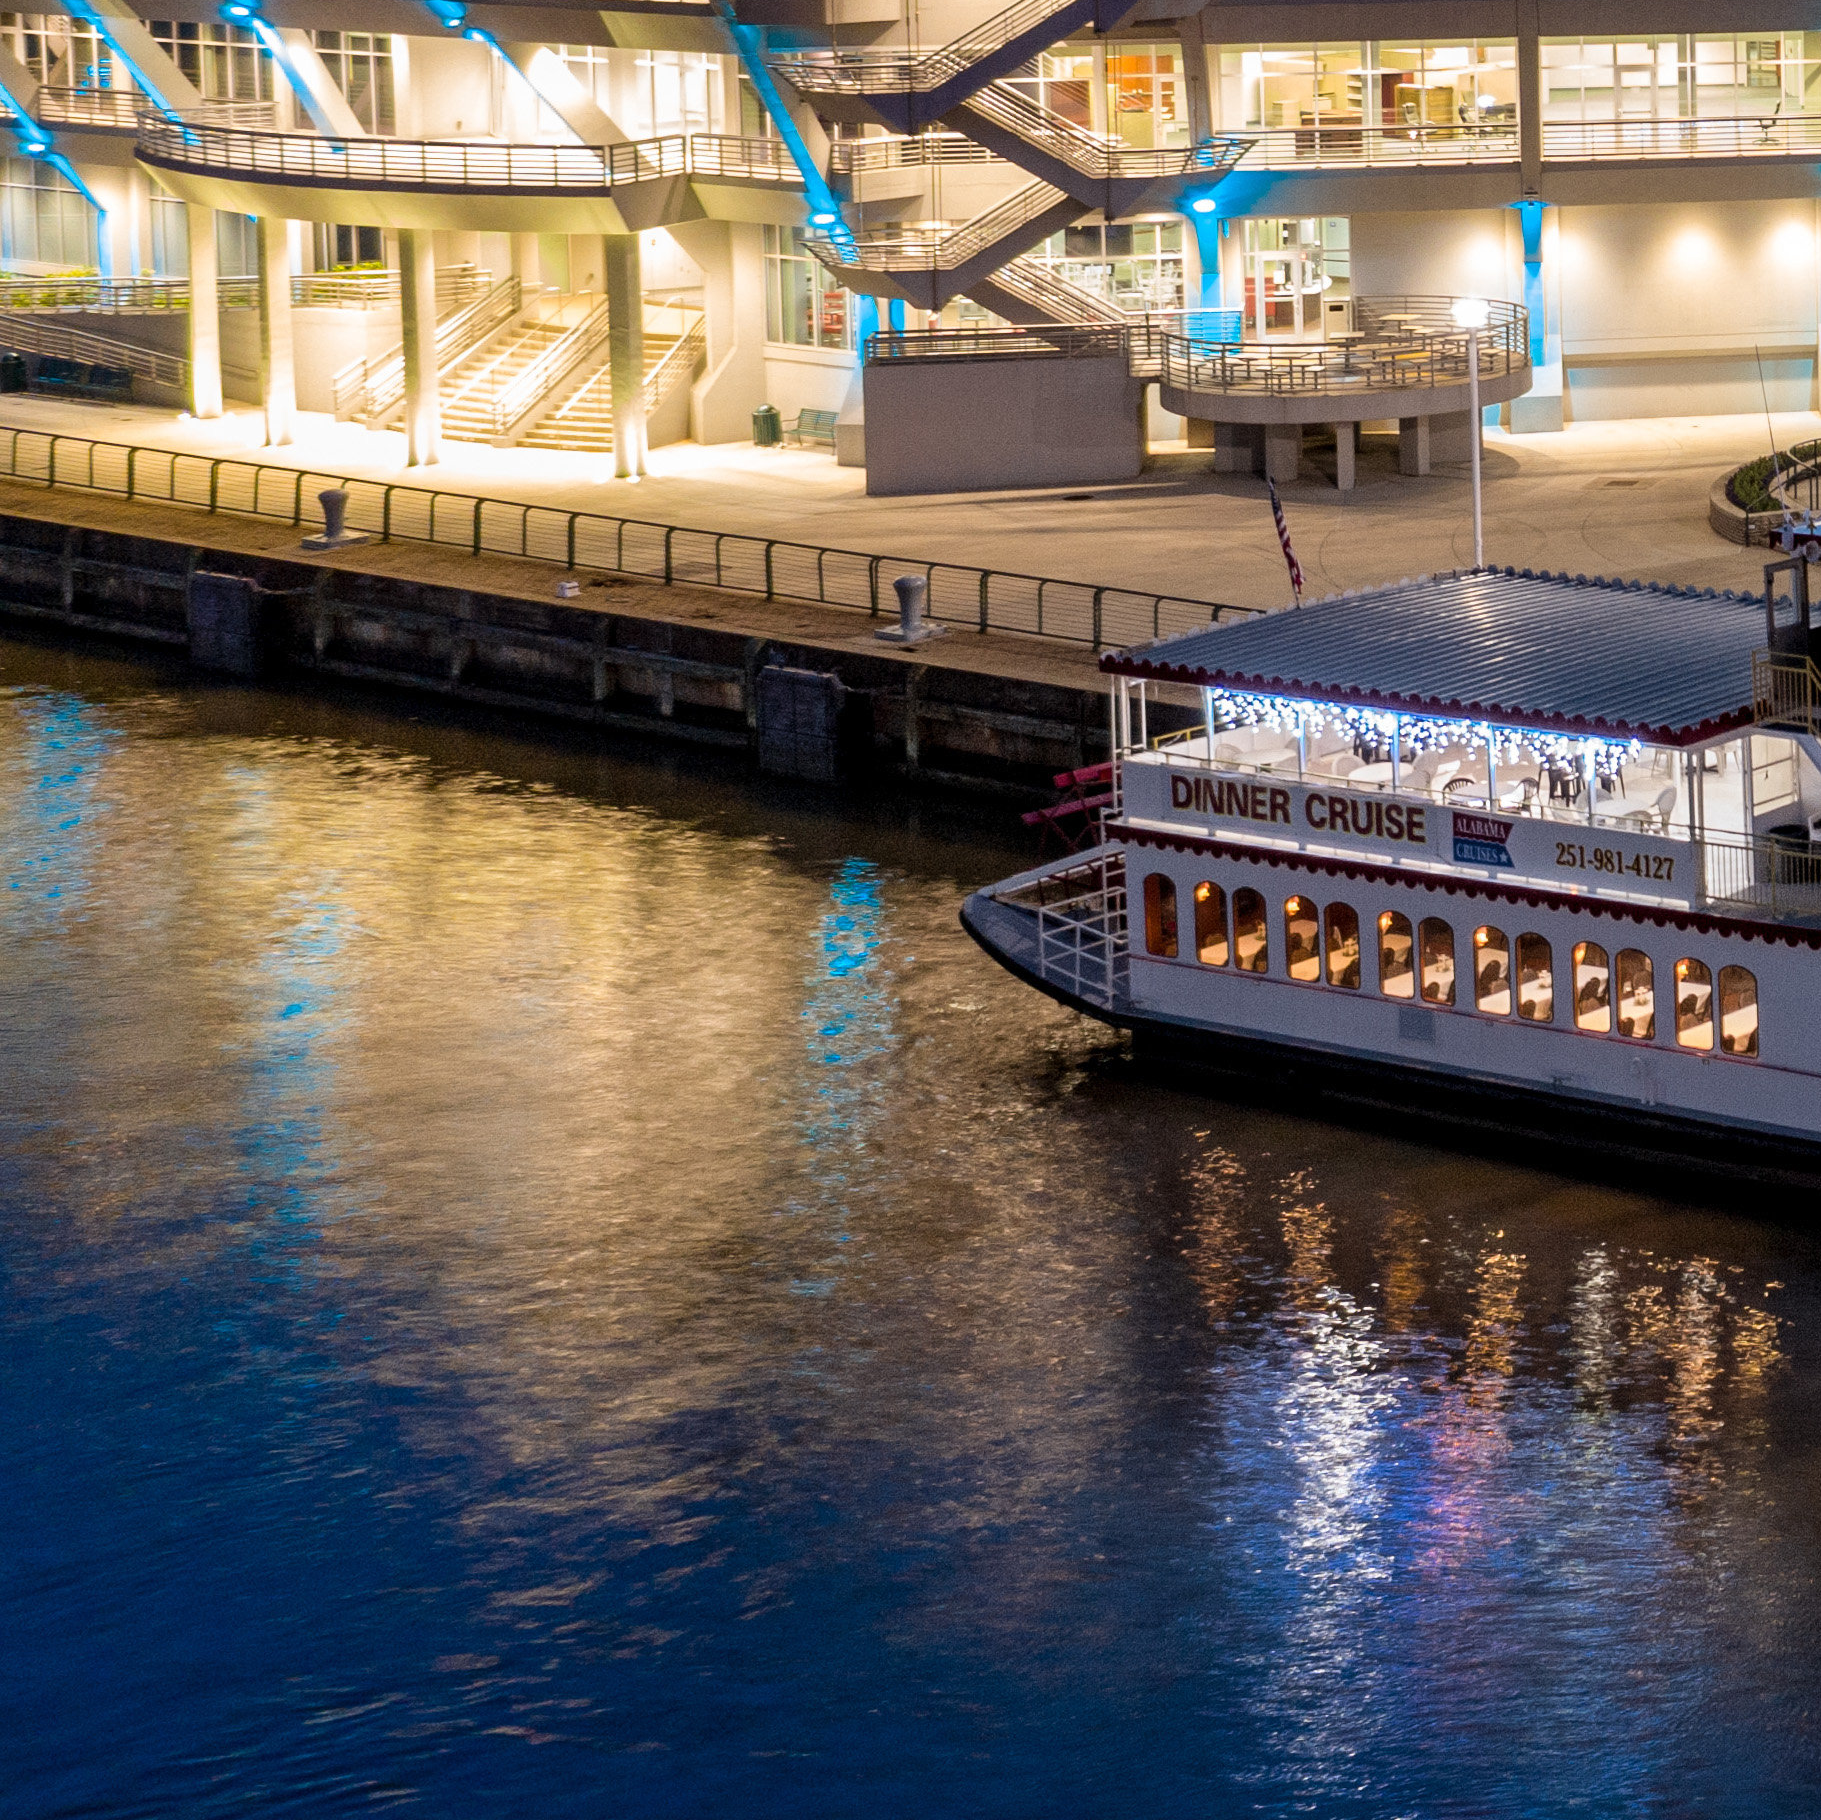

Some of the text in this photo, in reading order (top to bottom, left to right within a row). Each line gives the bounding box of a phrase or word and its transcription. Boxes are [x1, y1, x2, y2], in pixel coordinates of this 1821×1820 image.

[1170, 774, 1427, 844] DINNER CRUISE
[1456, 818, 1506, 839] ALABAMA
[1456, 842, 1498, 864] CRUISES
[1555, 841, 1675, 882] 251-981-4127
